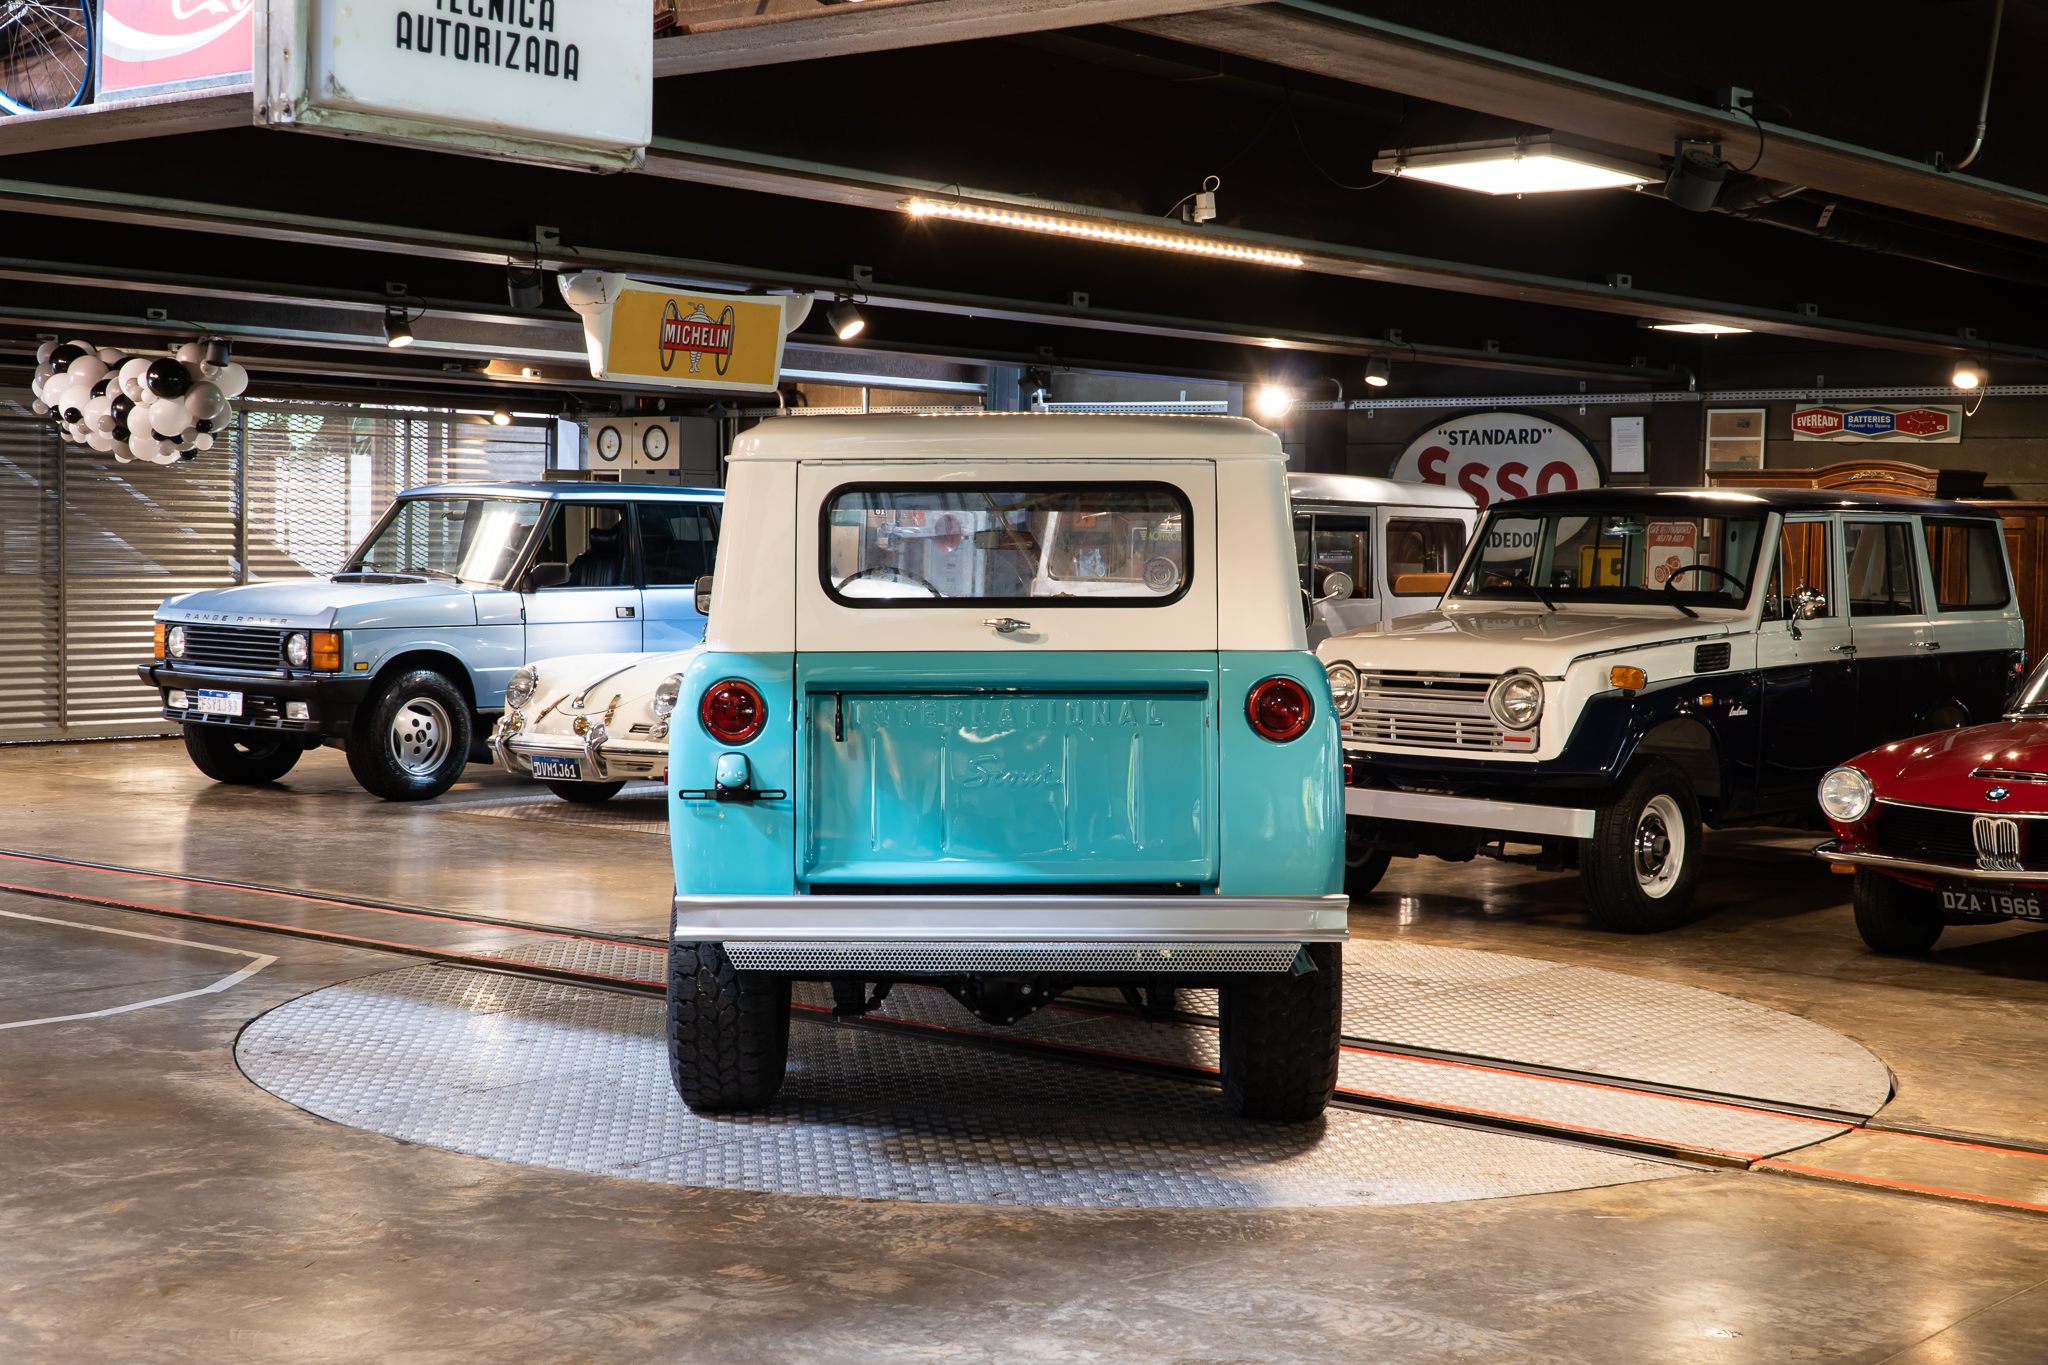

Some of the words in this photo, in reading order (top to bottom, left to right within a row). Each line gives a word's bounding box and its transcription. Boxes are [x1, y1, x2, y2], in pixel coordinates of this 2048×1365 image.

[396, 11, 580, 82] AUTORIZADA
[664, 323, 730, 349] MICHELIN
[1797, 414, 1839, 426] EVEREADY
[1848, 415, 1891, 423] BATTERIES
[185, 613, 229, 622] RANGE
[236, 616, 288, 625] ROVER
[851, 700, 1165, 728] INTERNATIONAL
[954, 754, 1064, 788] Scout
